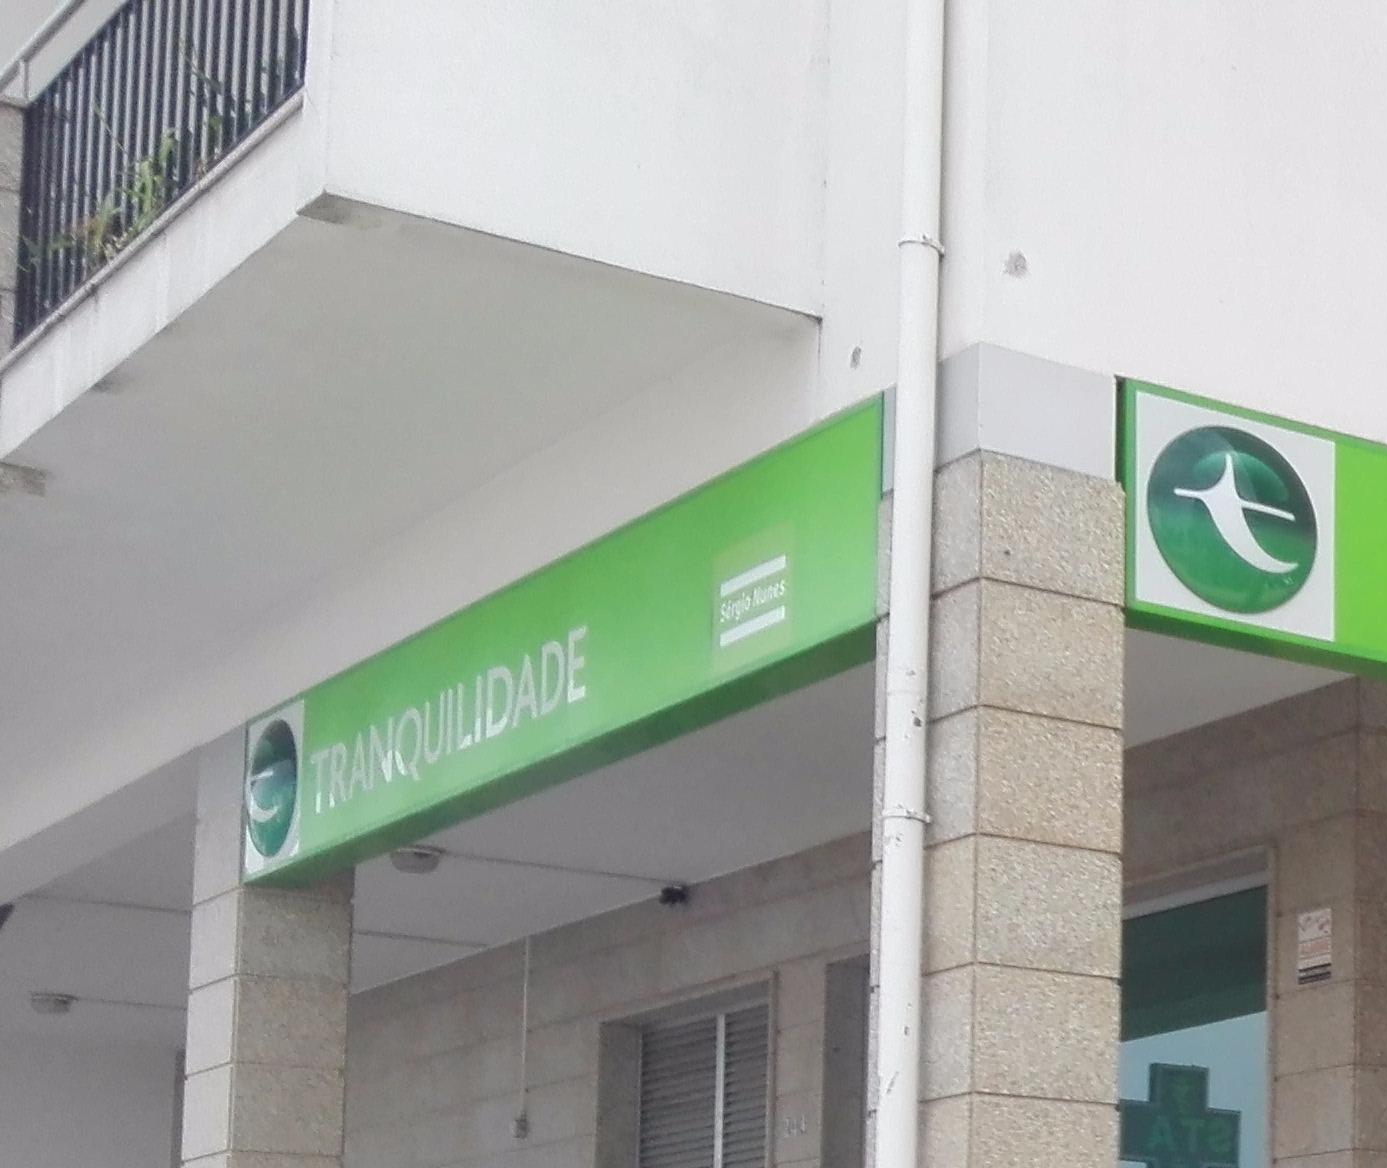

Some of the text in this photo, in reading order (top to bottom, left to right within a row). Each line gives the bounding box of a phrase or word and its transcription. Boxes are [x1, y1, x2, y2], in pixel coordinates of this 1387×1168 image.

[719, 579, 786, 622] Sérgio Nunes
[310, 625, 589, 814] TRANQUILIDADE
